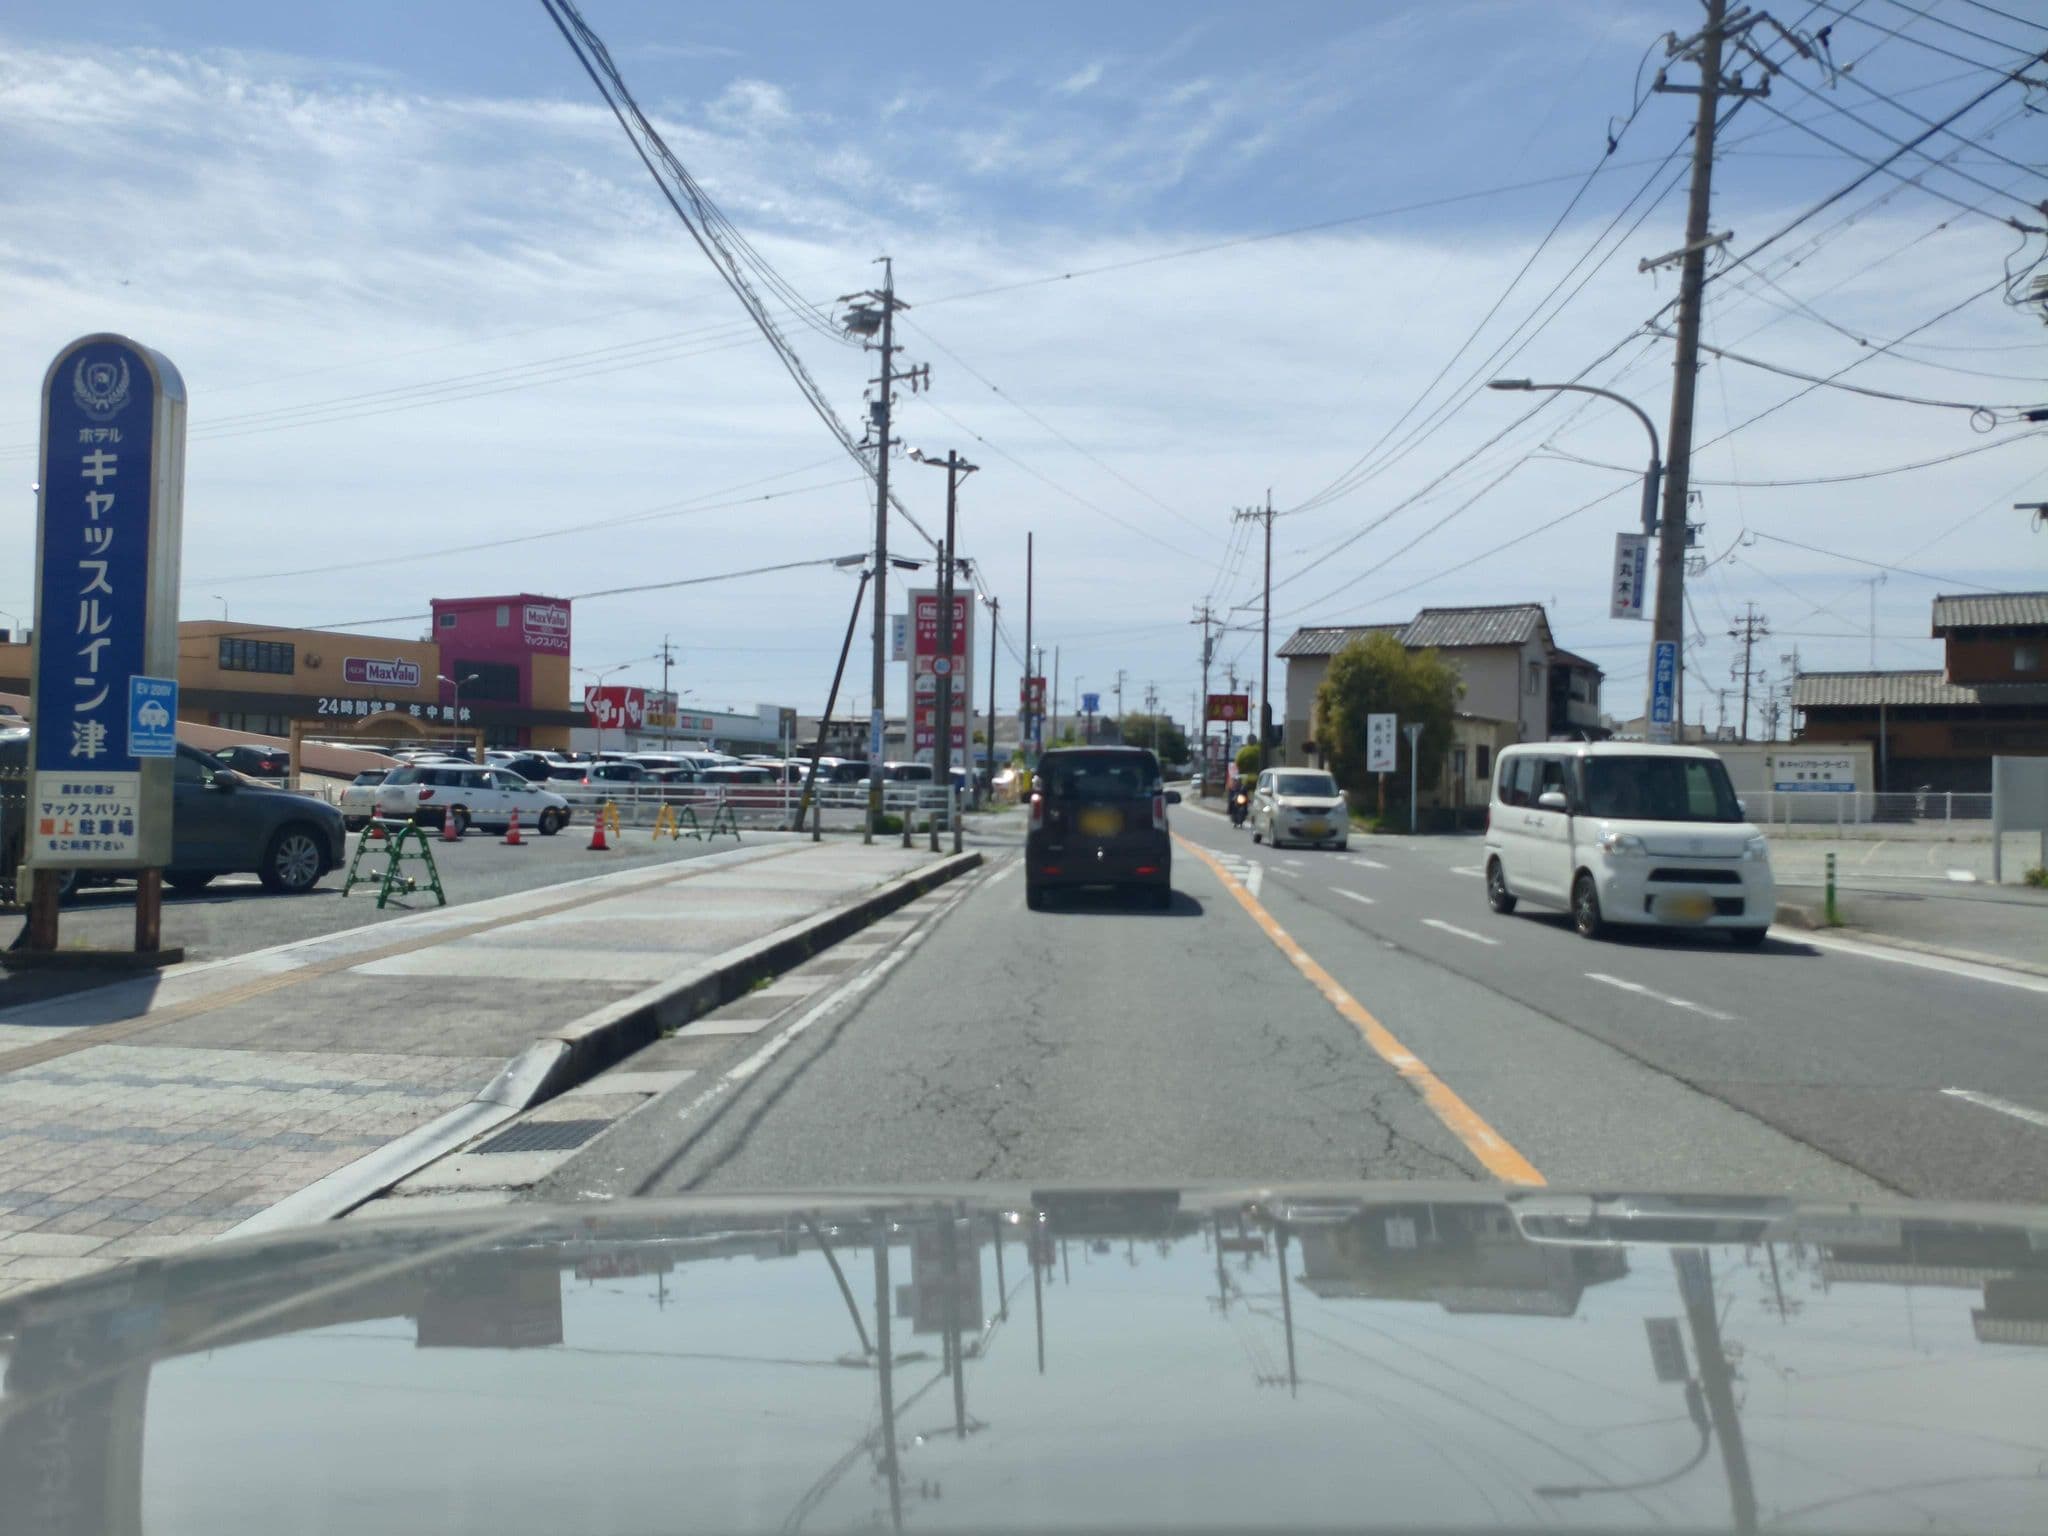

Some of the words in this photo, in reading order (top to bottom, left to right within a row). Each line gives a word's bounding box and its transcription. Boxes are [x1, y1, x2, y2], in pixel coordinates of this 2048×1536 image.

[79, 428, 123, 443] ホテル
[70, 448, 119, 759] キャッスルイン津
[528, 607, 565, 626] MaxValu
[369, 658, 416, 681] MaxValu
[42, 803, 133, 816] マックスバリュ
